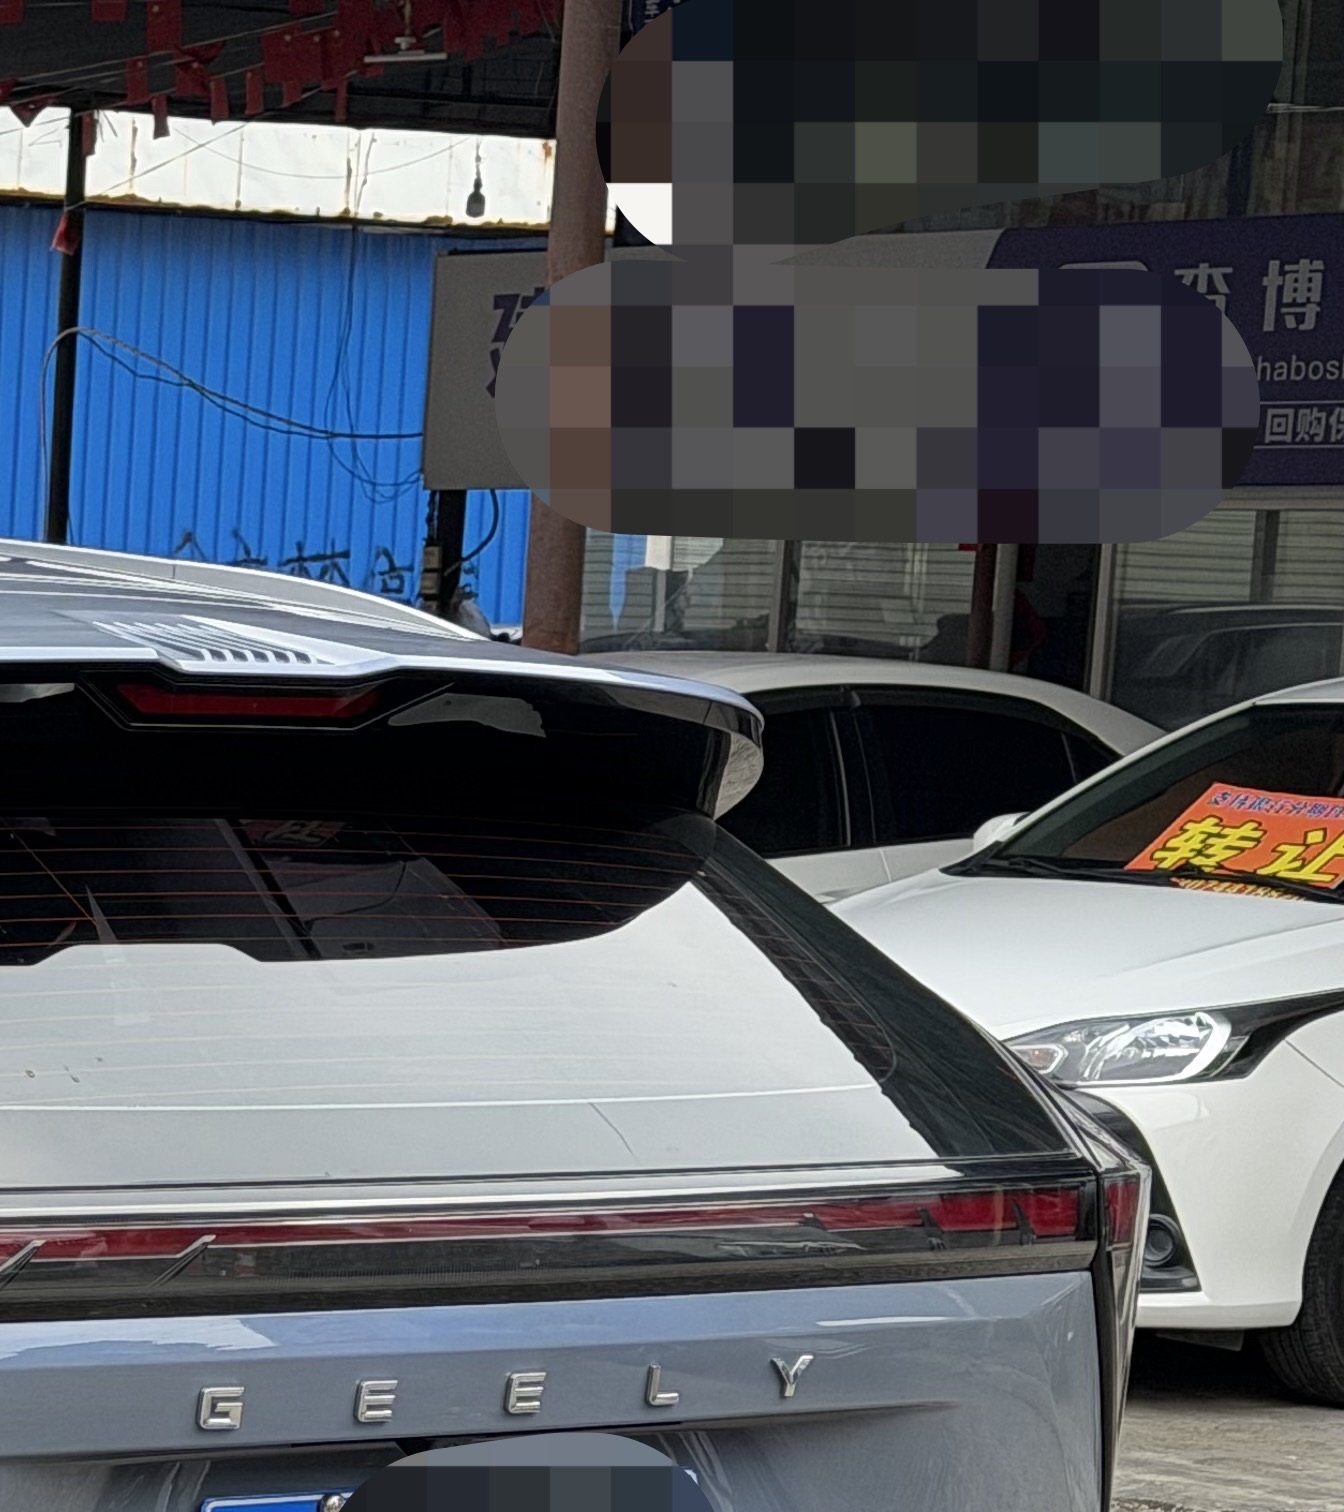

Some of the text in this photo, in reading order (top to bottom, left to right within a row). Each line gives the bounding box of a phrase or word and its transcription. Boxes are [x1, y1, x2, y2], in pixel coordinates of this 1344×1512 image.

[1257, 354, 1344, 382] habos
[1150, 815, 1344, 883] 转让
[197, 1354, 814, 1430] GEELY
